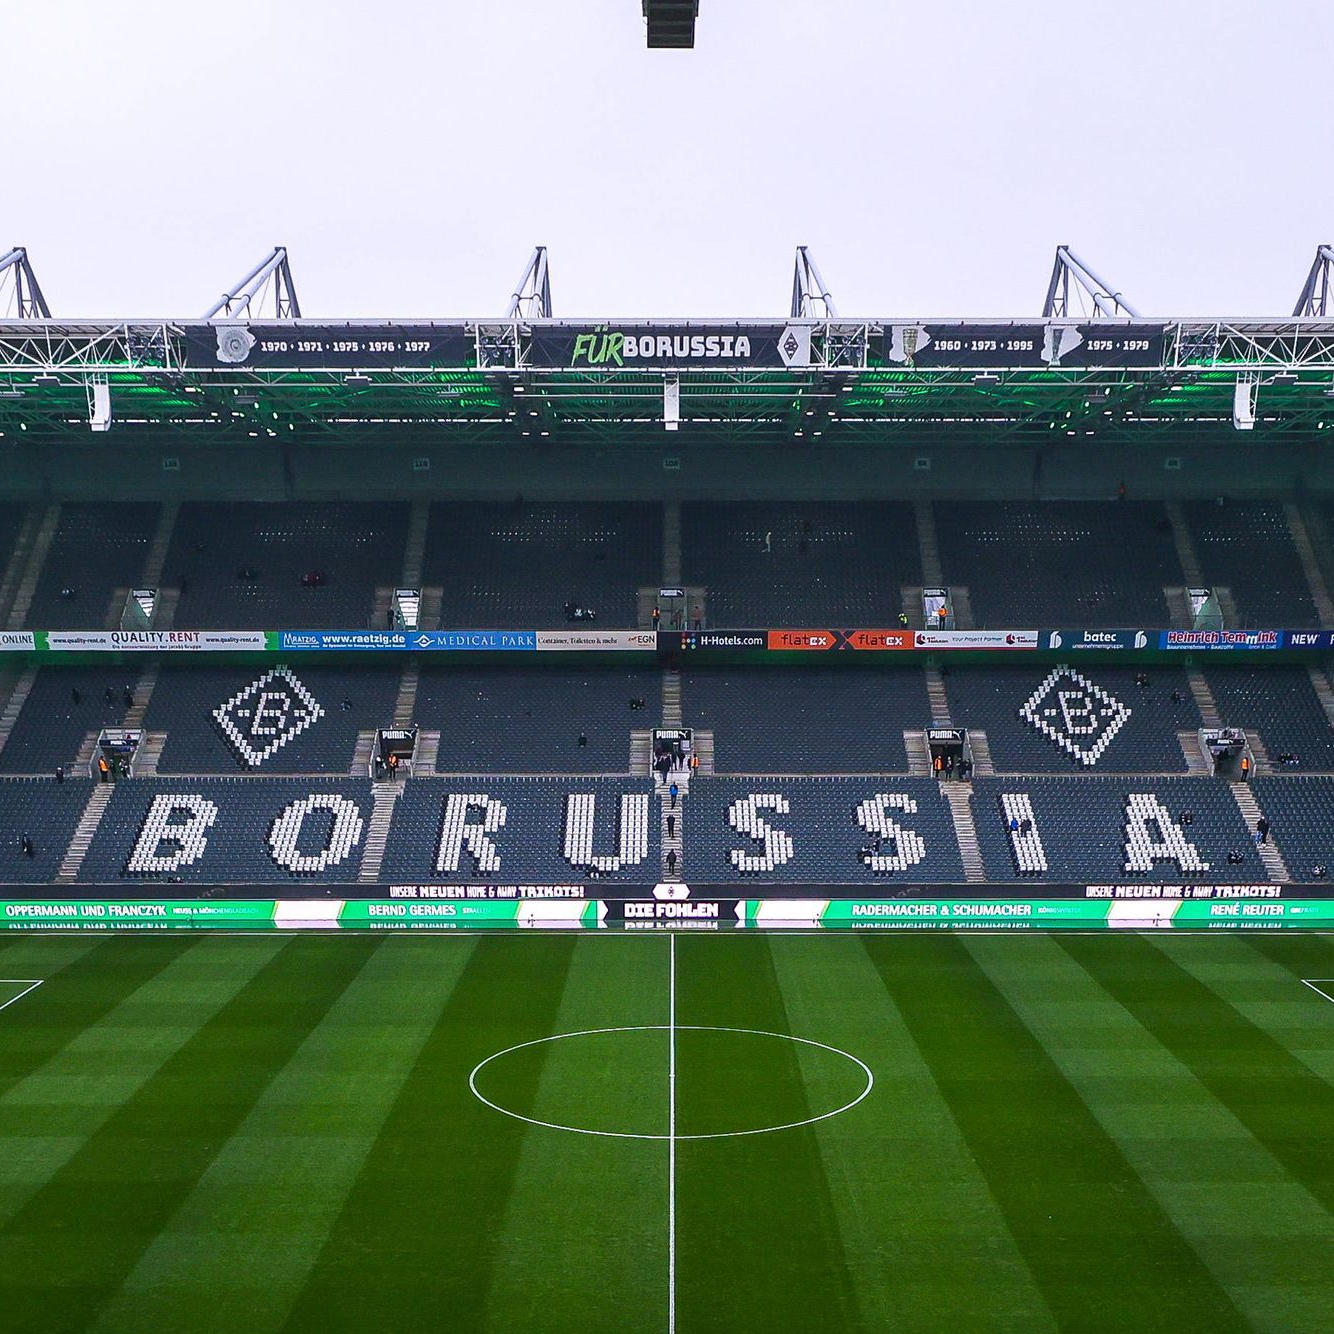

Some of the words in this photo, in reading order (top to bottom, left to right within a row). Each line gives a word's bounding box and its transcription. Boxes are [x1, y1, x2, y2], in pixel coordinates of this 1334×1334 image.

[261, 341, 287, 352] 1970
[298, 341, 323, 352] 1971
[333, 341, 359, 352] 1975
[369, 341, 394, 352] 1976
[405, 341, 431, 352] 1977
[934, 340, 962, 351] 1960
[971, 340, 998, 351] 1973
[1007, 340, 1034, 351] 1995
[1087, 340, 1113, 351] 1975
[1123, 340, 1149, 351] 1979
[1, 634, 34, 645] ONLINE
[52, 637, 107, 646] www.quality-rent.de
[110, 631, 201, 644] QUALITY.RENT
[322, 633, 406, 645] www.raetzig.de
[436, 635, 497, 646] MEDICAL
[501, 635, 534, 646] PARK
[537, 636, 570, 646] Container,
[570, 635, 596, 645] Toiletten
[602, 636, 618, 645] mehr
[637, 635, 655, 644] EGN
[701, 636, 764, 646] H-Hotels.com
[1082, 631, 1117, 643] batec
[1167, 631, 1219, 644] Heinrich
[1291, 634, 1319, 645] NEW
[655, 730, 678, 740] PUMA
[126, 793, 1211, 872] BORUSSIA
[389, 885, 418, 898] UNSERE
[419, 885, 465, 898] NEUEN
[466, 885, 489, 898] HOME
[497, 885, 517, 898] AWAY
[518, 884, 586, 898] TRIKOTS!
[1085, 885, 1115, 898] UNSERE
[1114, 885, 1162, 898] NEUEN
[1162, 885, 1184, 898] HOME
[1192, 885, 1213, 898] AWAY
[1214, 884, 1283, 898] TRIKOTS!
[5, 904, 79, 918] OPPERMANN
[80, 904, 106, 918] UND
[107, 904, 168, 918] FRANCZYK
[368, 904, 407, 917] BERND
[409, 904, 457, 917] GERMES
[623, 902, 655, 918] DIE
[655, 902, 720, 918] FOHLEN
[851, 904, 938, 917] RADERMACHER
[939, 904, 950, 917] &
[951, 904, 1032, 917] SCHUMACHER
[1210, 902, 1241, 916] RENÉ
[1241, 904, 1286, 916] REUTER
